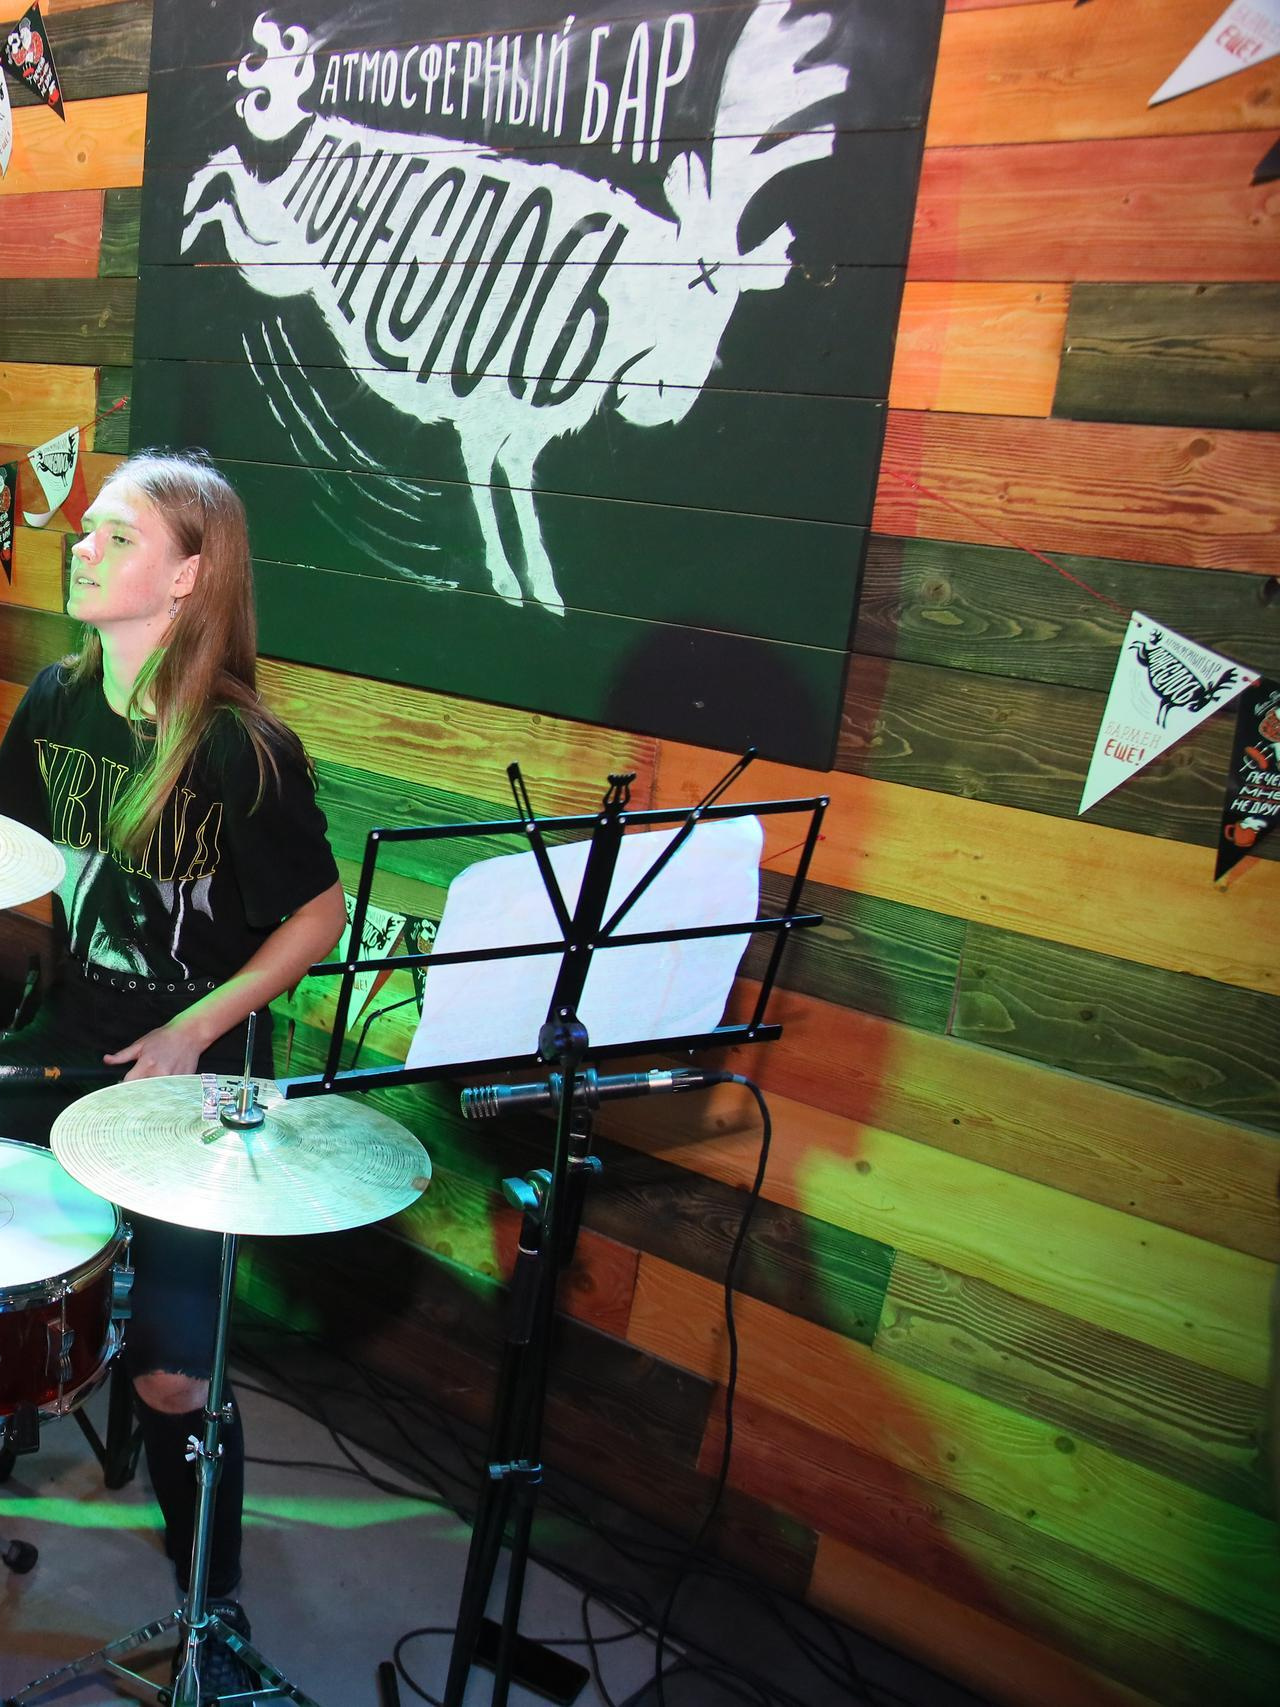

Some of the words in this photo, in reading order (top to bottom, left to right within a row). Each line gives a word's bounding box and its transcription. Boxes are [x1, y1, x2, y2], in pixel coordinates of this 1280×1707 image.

[320, 15, 572, 138] АТМОСФЕРНЫЙ
[581, 13, 695, 163] БАР
[283, 132, 628, 406] ПОНЕСЛОСЬ
